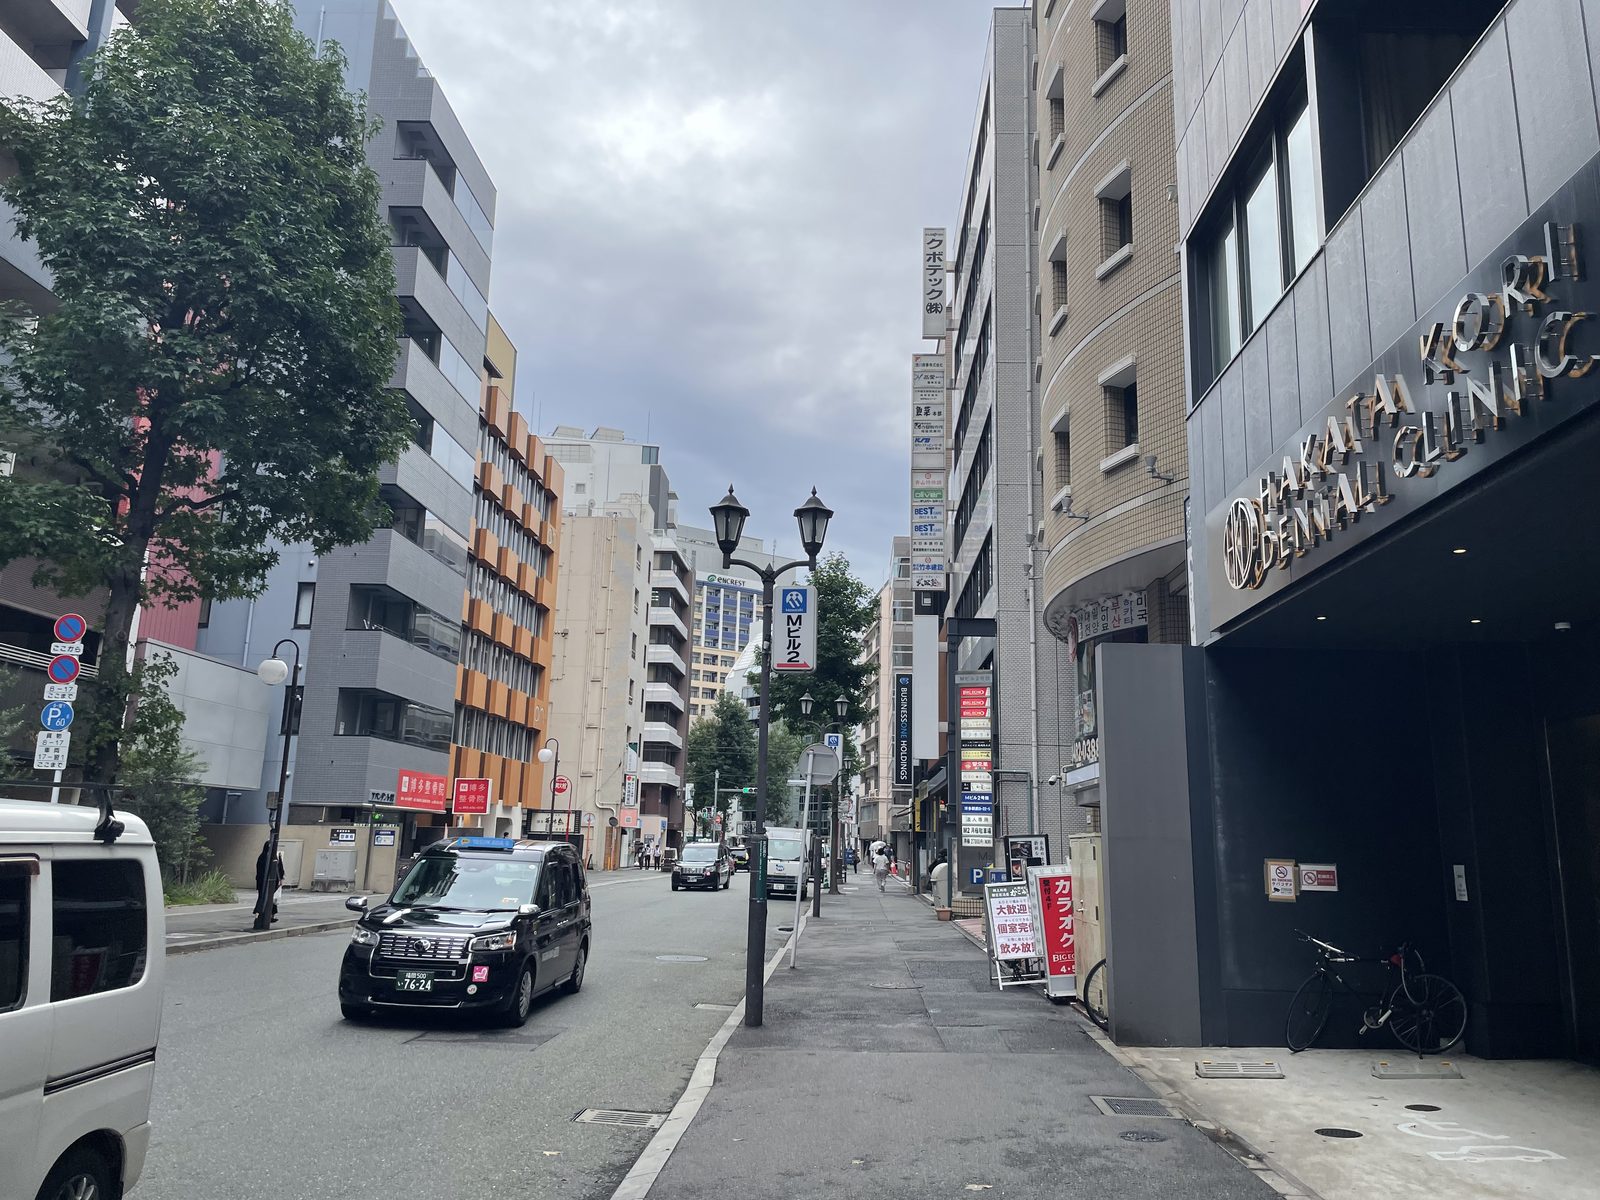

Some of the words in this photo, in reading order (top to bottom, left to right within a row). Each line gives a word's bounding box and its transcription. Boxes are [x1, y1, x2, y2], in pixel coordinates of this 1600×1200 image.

[914, 507, 934, 515] BEST
[914, 524, 934, 532] BEST
[1111, 598, 1121, 629] 부산
[786, 615, 802, 663] Mビル2
[53, 645, 81, 653] ここから
[47, 707, 61, 726] P
[56, 718, 66, 726] 60
[900, 740, 908, 780] HOLDINGS
[469, 783, 485, 792] 博多
[459, 794, 485, 803] 整骨院
[973, 868, 984, 883] P
[1055, 879, 1075, 948] カラオケ
[1053, 954, 1068, 963] BIG
[404, 979, 432, 990] 76-24
